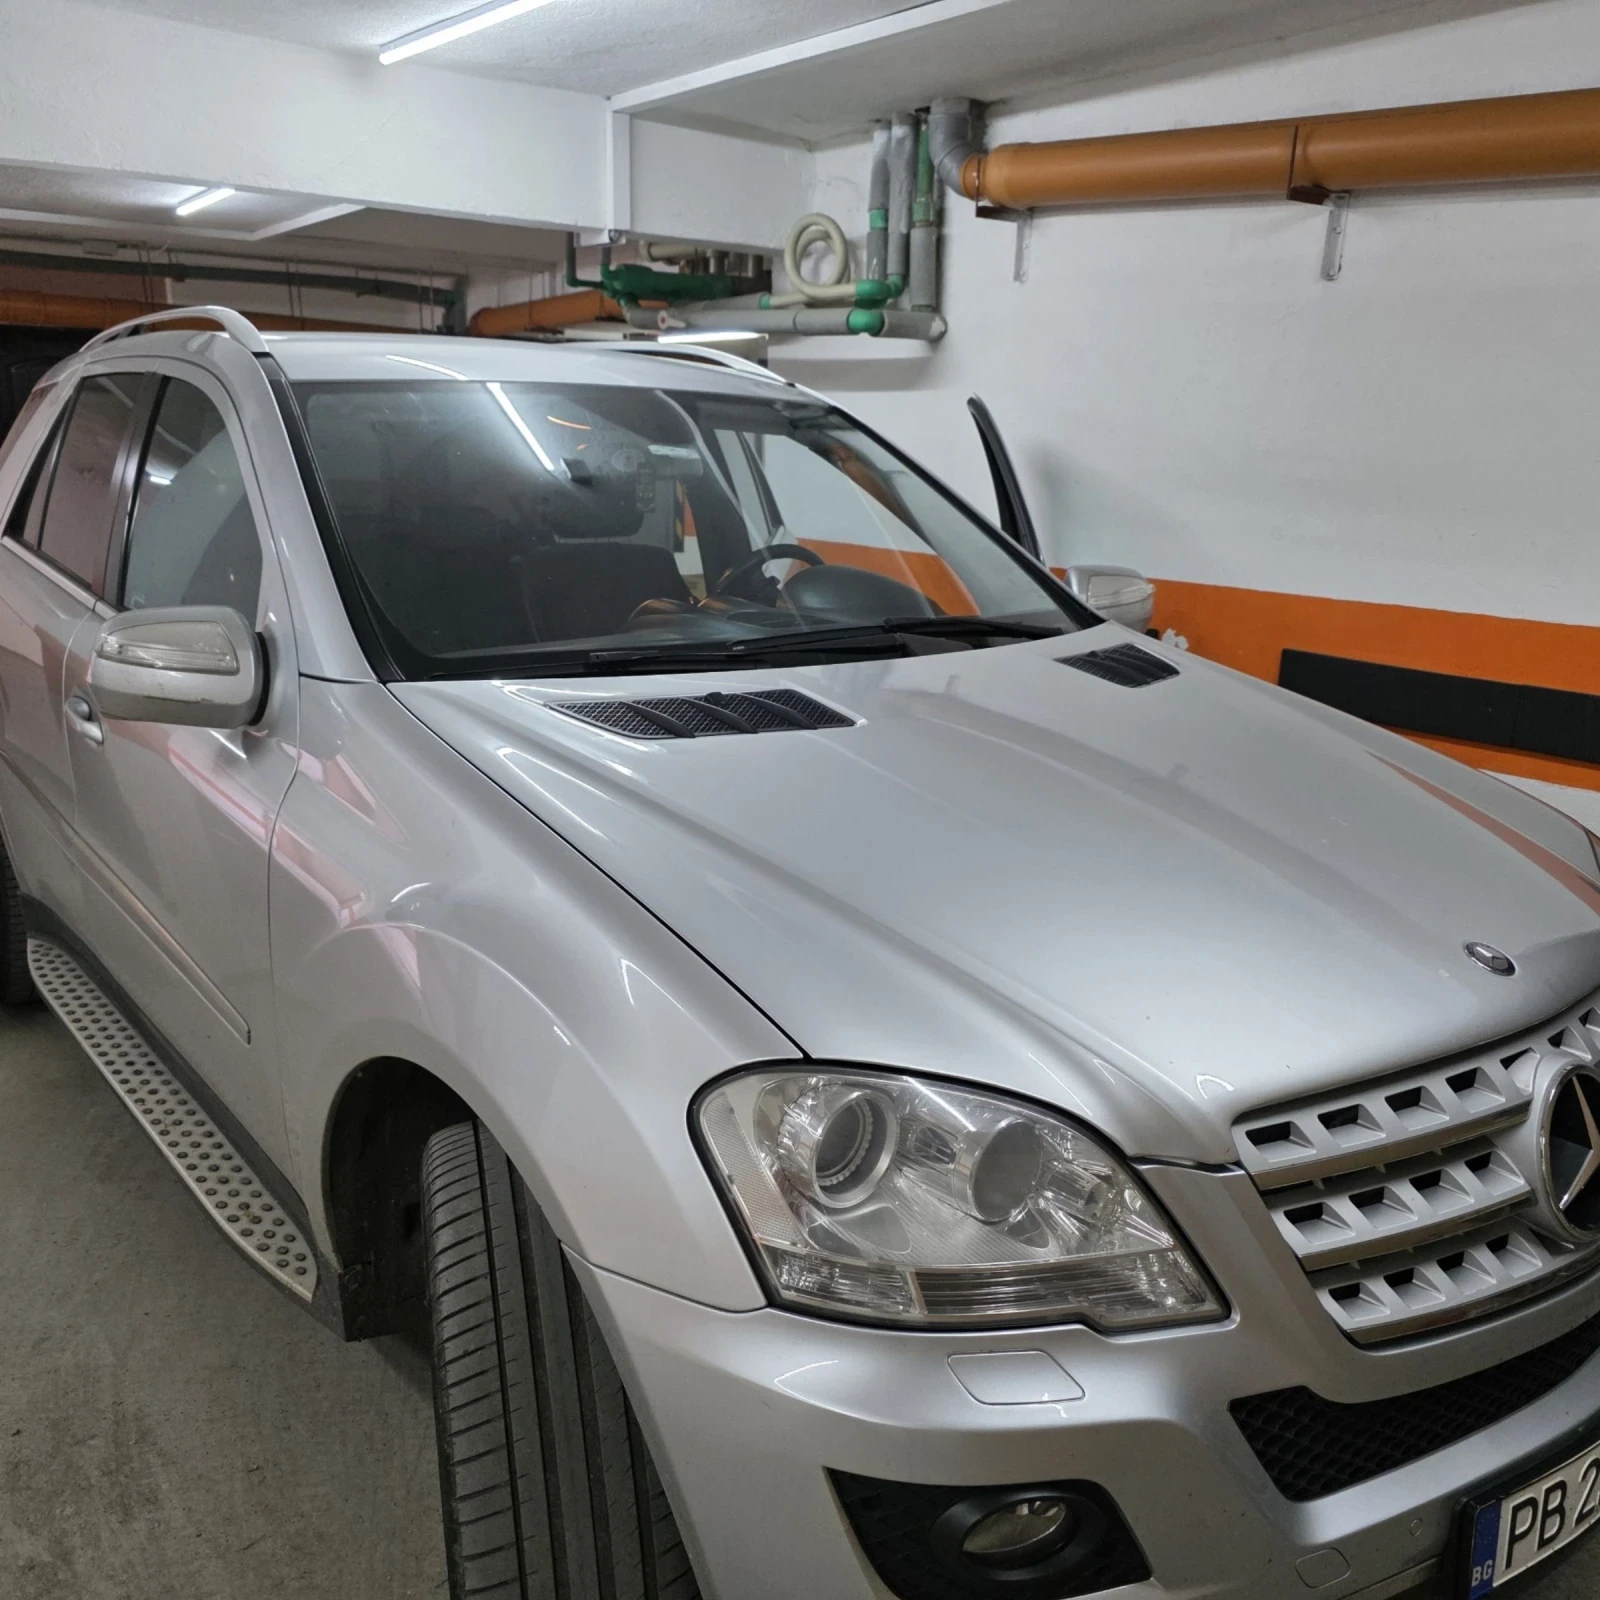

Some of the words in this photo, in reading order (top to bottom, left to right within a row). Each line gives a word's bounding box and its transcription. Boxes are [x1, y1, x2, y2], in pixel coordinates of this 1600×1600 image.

[1504, 1478, 1567, 1570] PB
[1573, 1457, 1600, 1527] 2
[1471, 1559, 1494, 1587] BG
